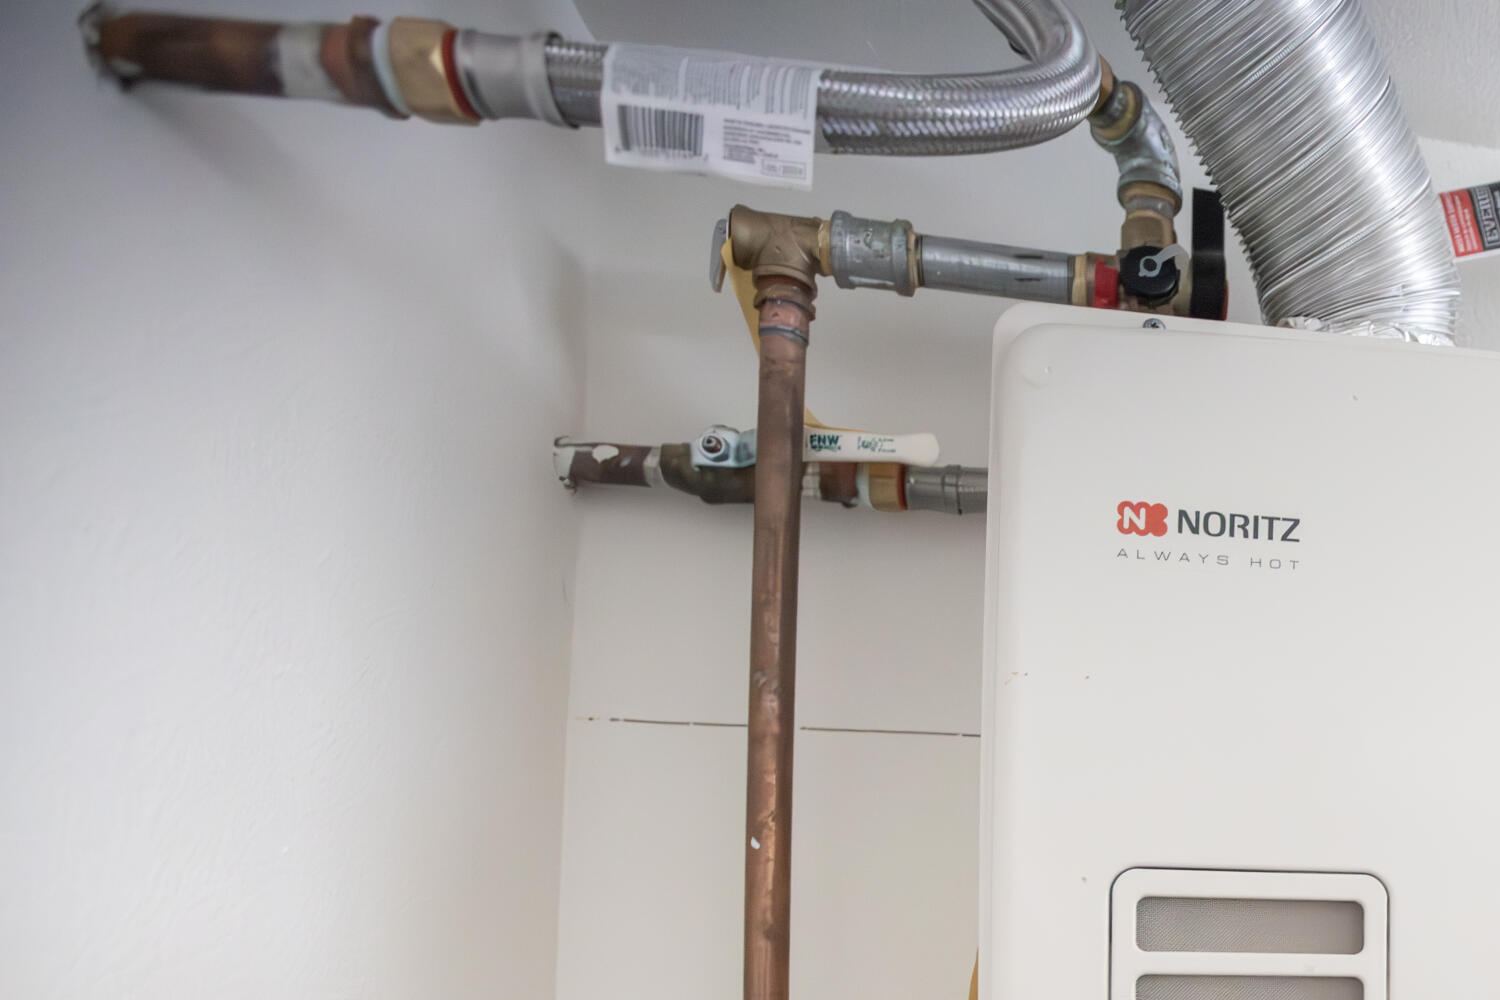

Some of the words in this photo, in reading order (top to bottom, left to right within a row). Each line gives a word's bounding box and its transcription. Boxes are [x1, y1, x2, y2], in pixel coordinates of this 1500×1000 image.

[1177, 508, 1301, 543] NORITZ
[1116, 547, 1230, 567] ALWAYS
[1249, 557, 1300, 571] HOT
